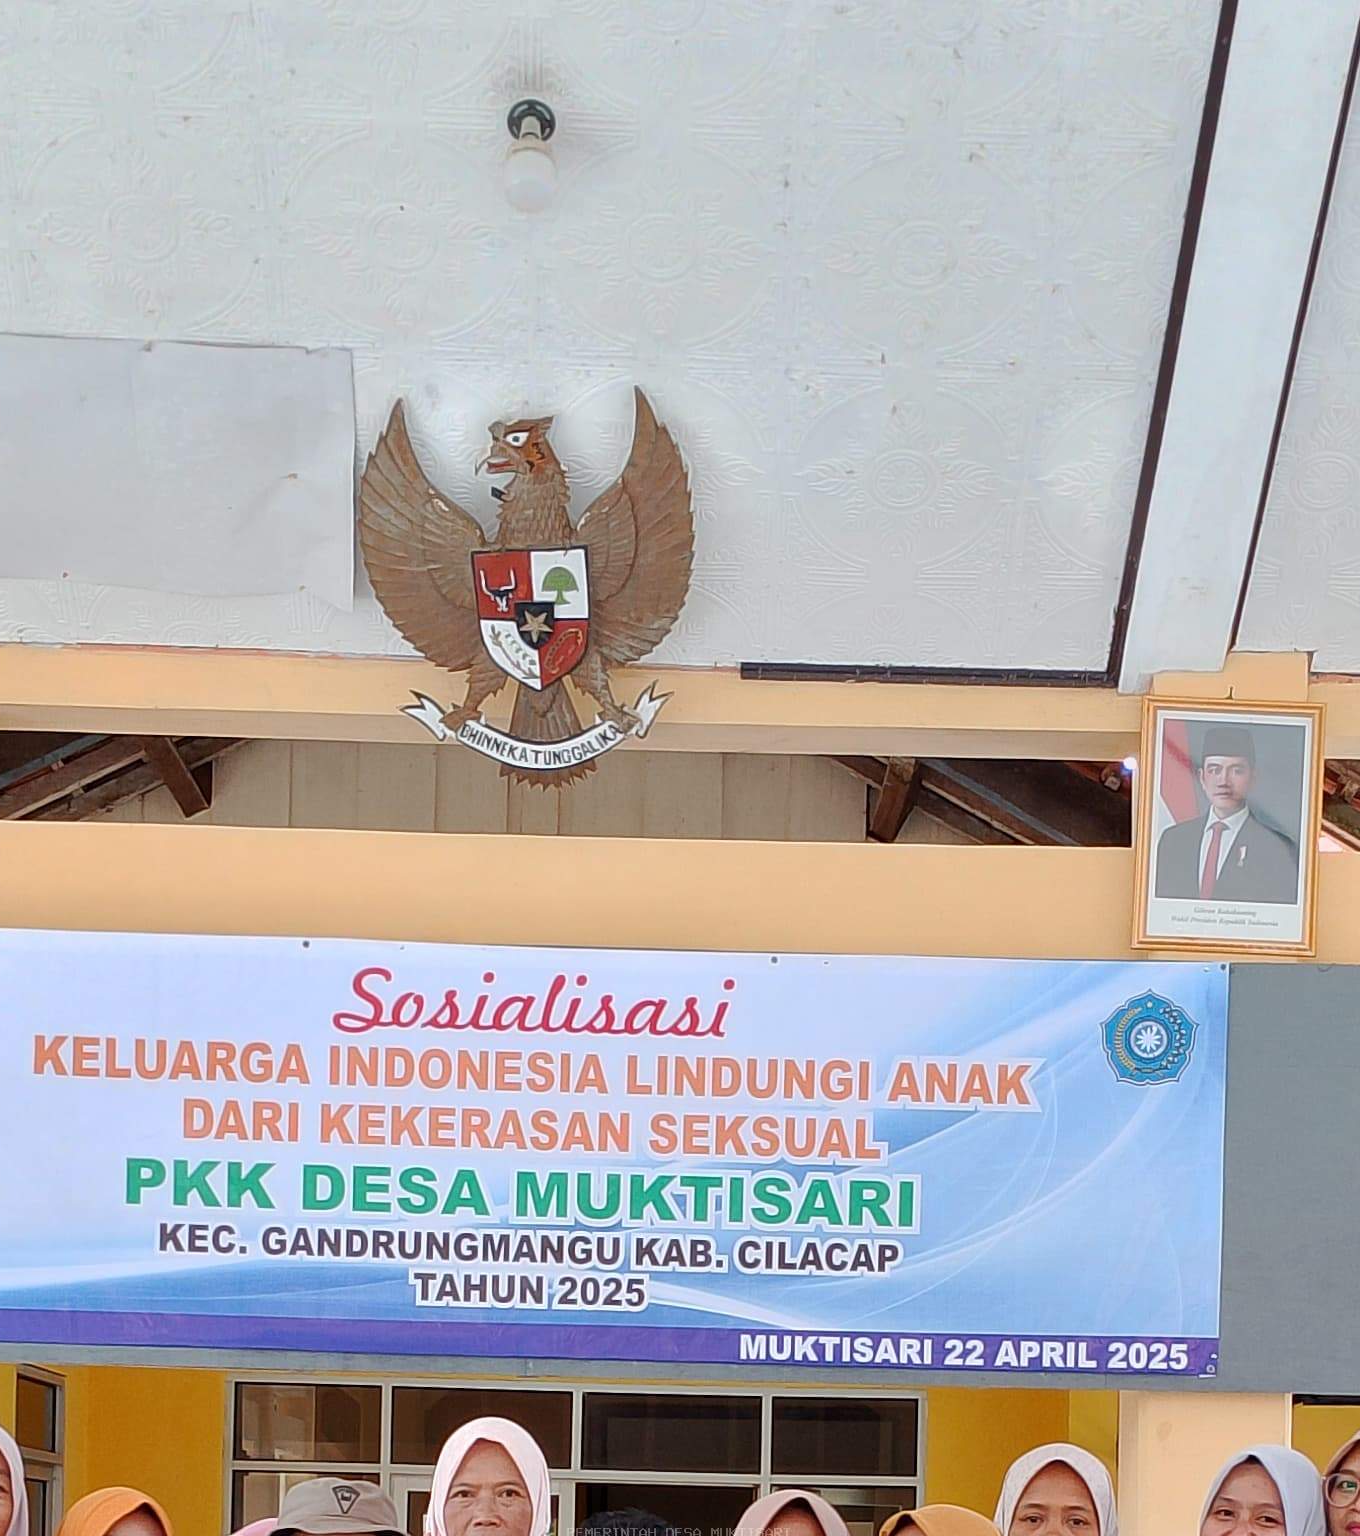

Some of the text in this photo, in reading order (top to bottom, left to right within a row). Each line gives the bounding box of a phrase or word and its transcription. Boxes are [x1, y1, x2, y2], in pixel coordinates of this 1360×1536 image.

[460, 723, 623, 766] BHINNEKA TUNGGAL IKA
[333, 966, 735, 1038] Sosialisasi
[33, 1034, 1032, 1105] KELUARGA INDONESIA LINDUNGI ANAK
[182, 1097, 882, 1160] DARI KEKERASAN SEKSUAL
[124, 1157, 915, 1228] PKK DESA MUKTISARI
[158, 1222, 900, 1273] KEC. GANDRUNGMANGU KAB. CILACAP
[414, 1272, 646, 1307] TAHUN 2025
[739, 1333, 1189, 1370] MUKTISARI 22 APRIL 2025
